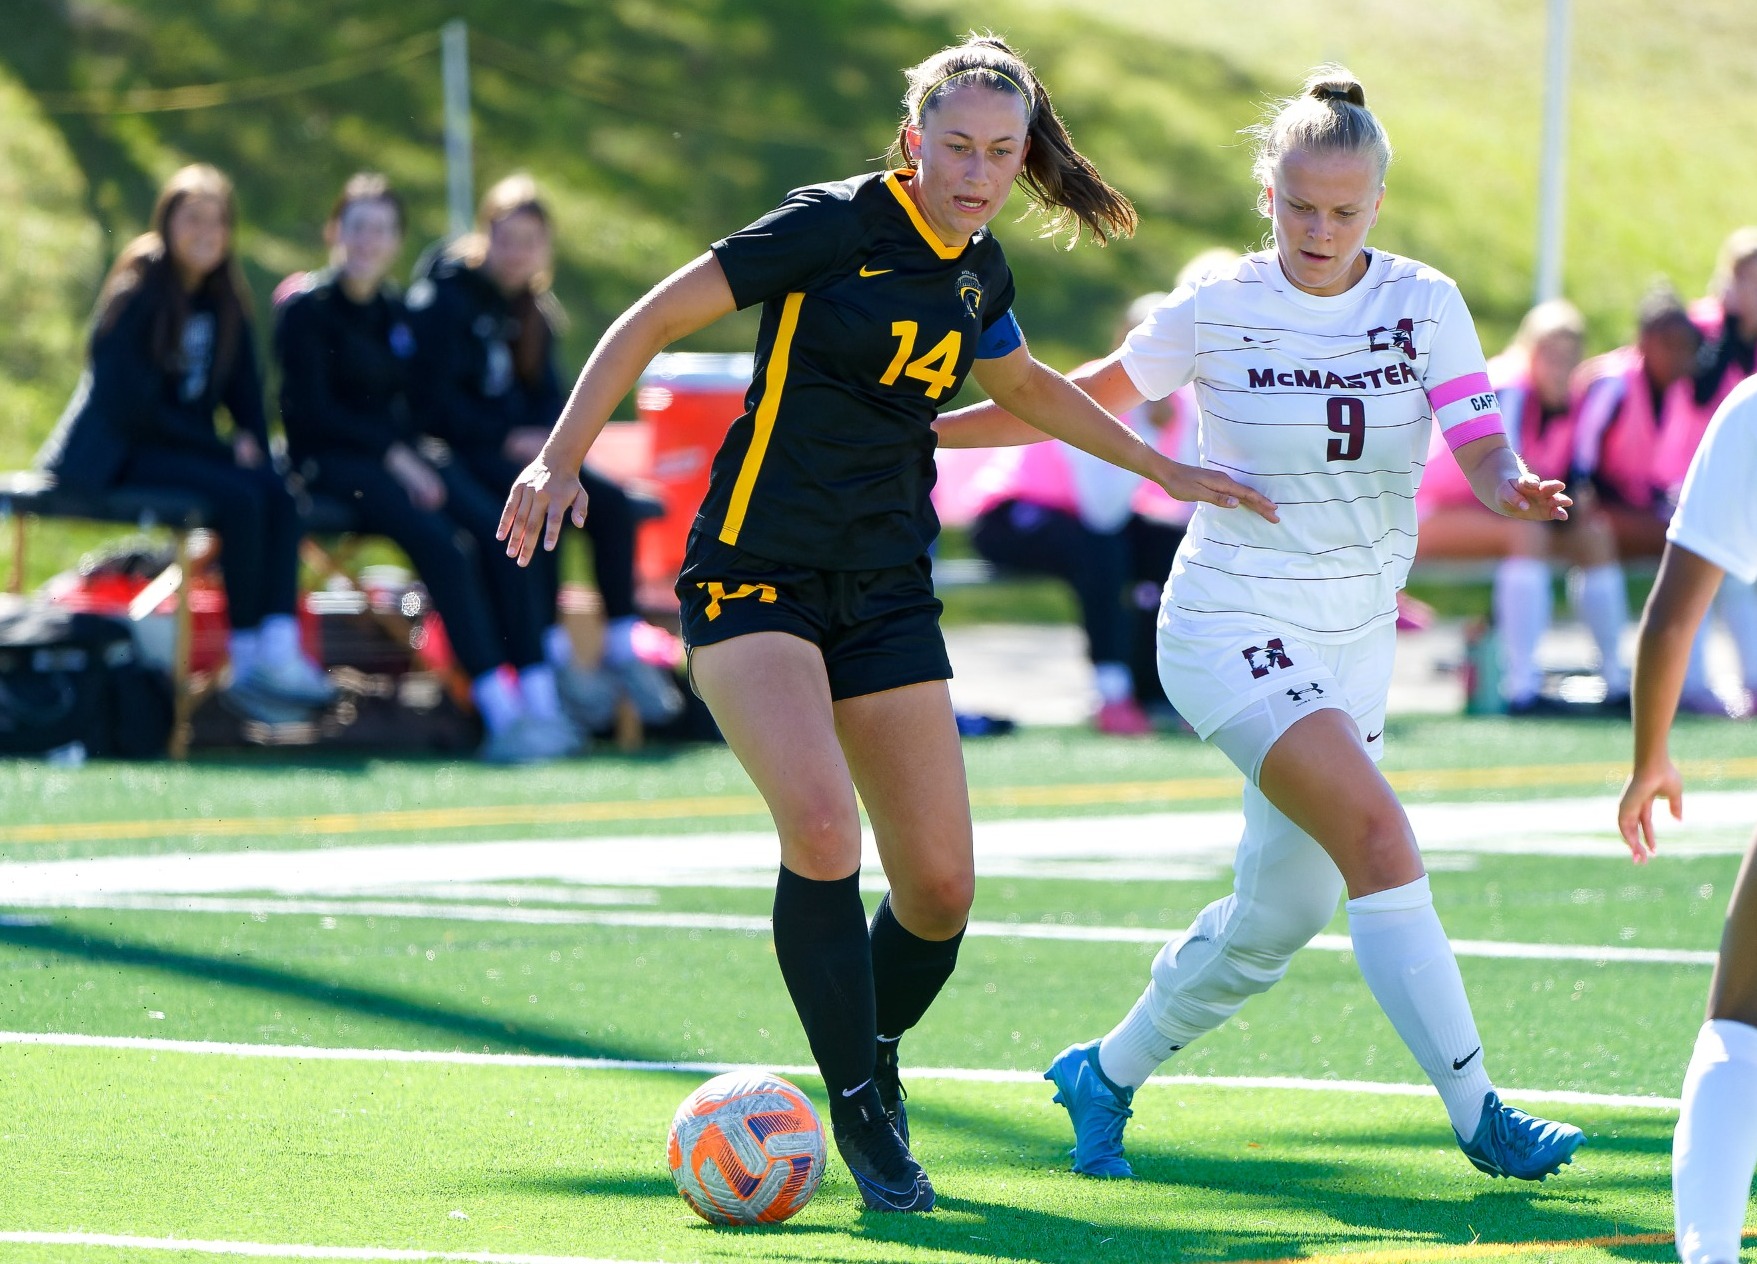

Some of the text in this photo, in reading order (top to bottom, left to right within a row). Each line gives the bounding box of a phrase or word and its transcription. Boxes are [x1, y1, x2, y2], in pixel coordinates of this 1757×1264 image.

[878, 320, 962, 399] 14
[1247, 362, 1418, 389] McMASTER
[1326, 396, 1366, 463] 9
